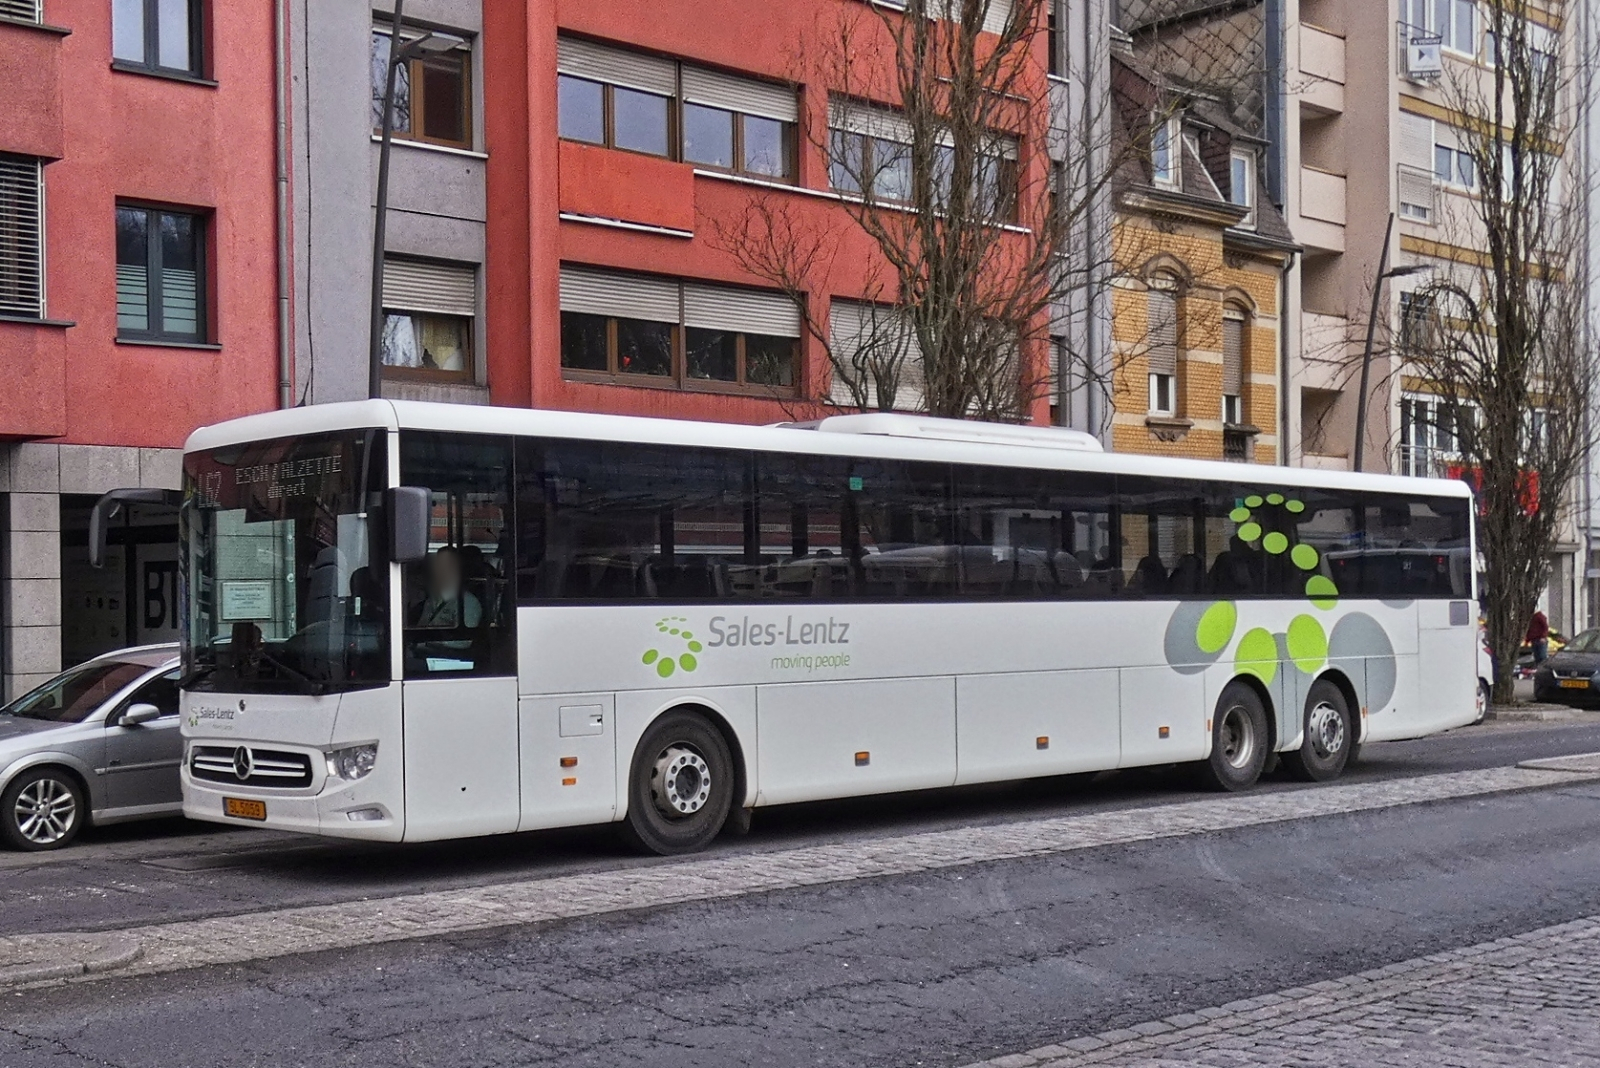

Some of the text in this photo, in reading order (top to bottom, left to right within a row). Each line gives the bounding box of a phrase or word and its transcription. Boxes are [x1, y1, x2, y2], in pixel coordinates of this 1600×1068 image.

[707, 615, 850, 648] Sales-Lentz
[771, 652, 850, 673] moving people
[199, 706, 235, 720] Sales-Lentz
